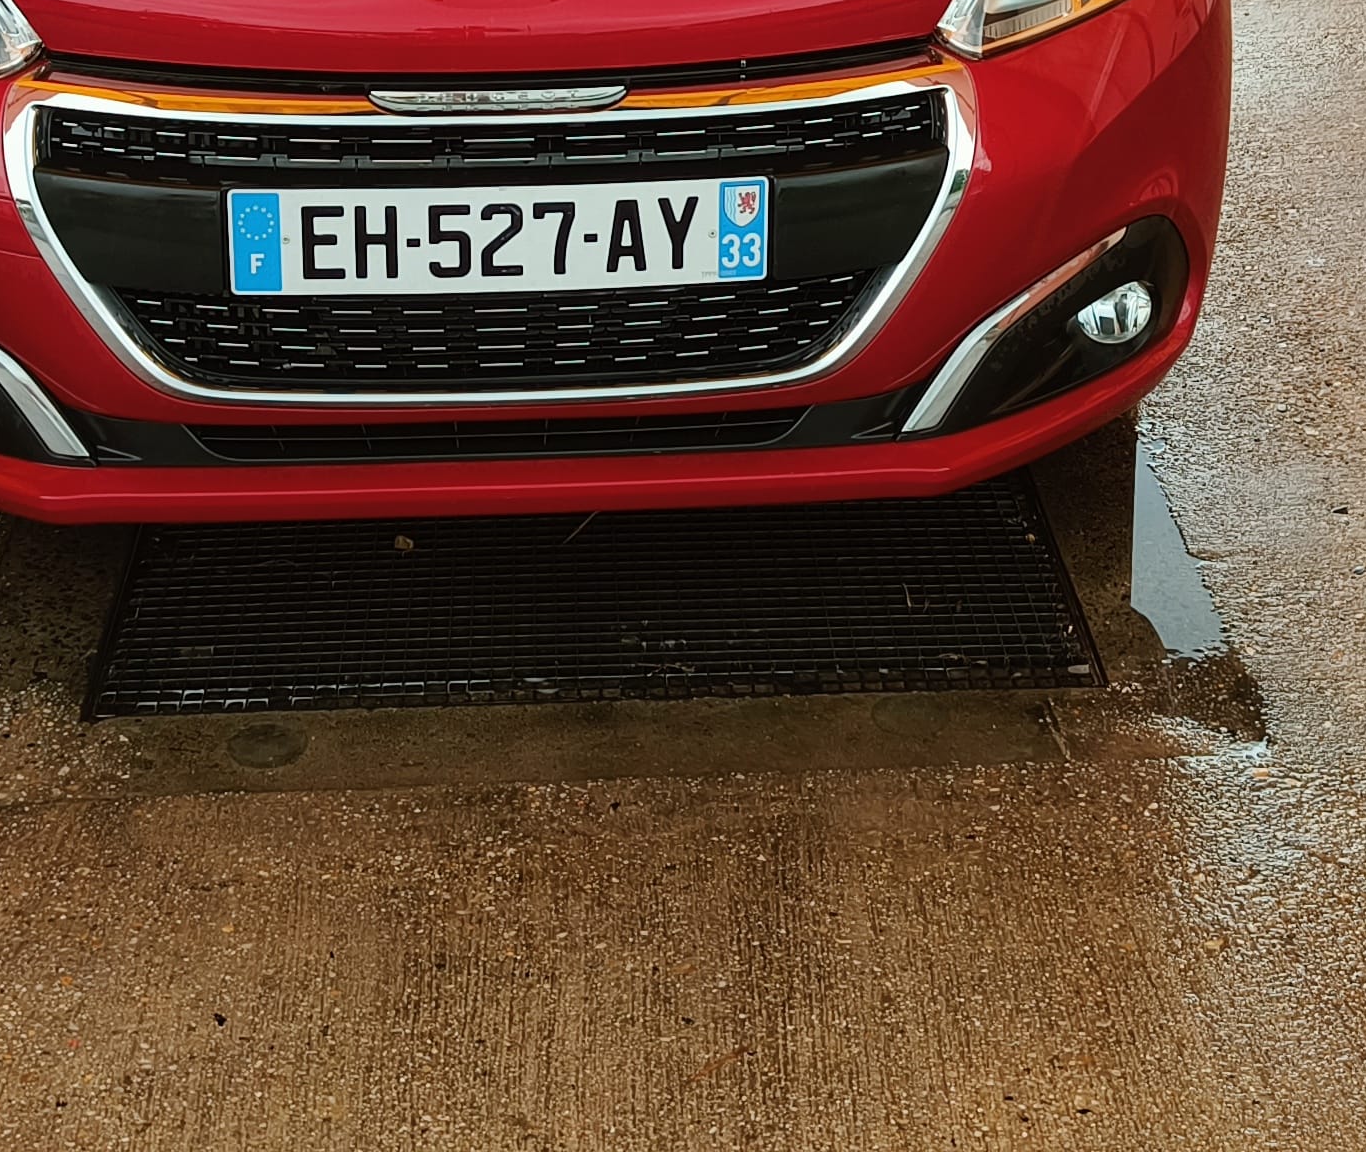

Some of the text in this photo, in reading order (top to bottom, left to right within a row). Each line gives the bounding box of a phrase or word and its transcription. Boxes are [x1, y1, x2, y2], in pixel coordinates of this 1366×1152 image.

[249, 196, 762, 280] F EH-527-AY 33
